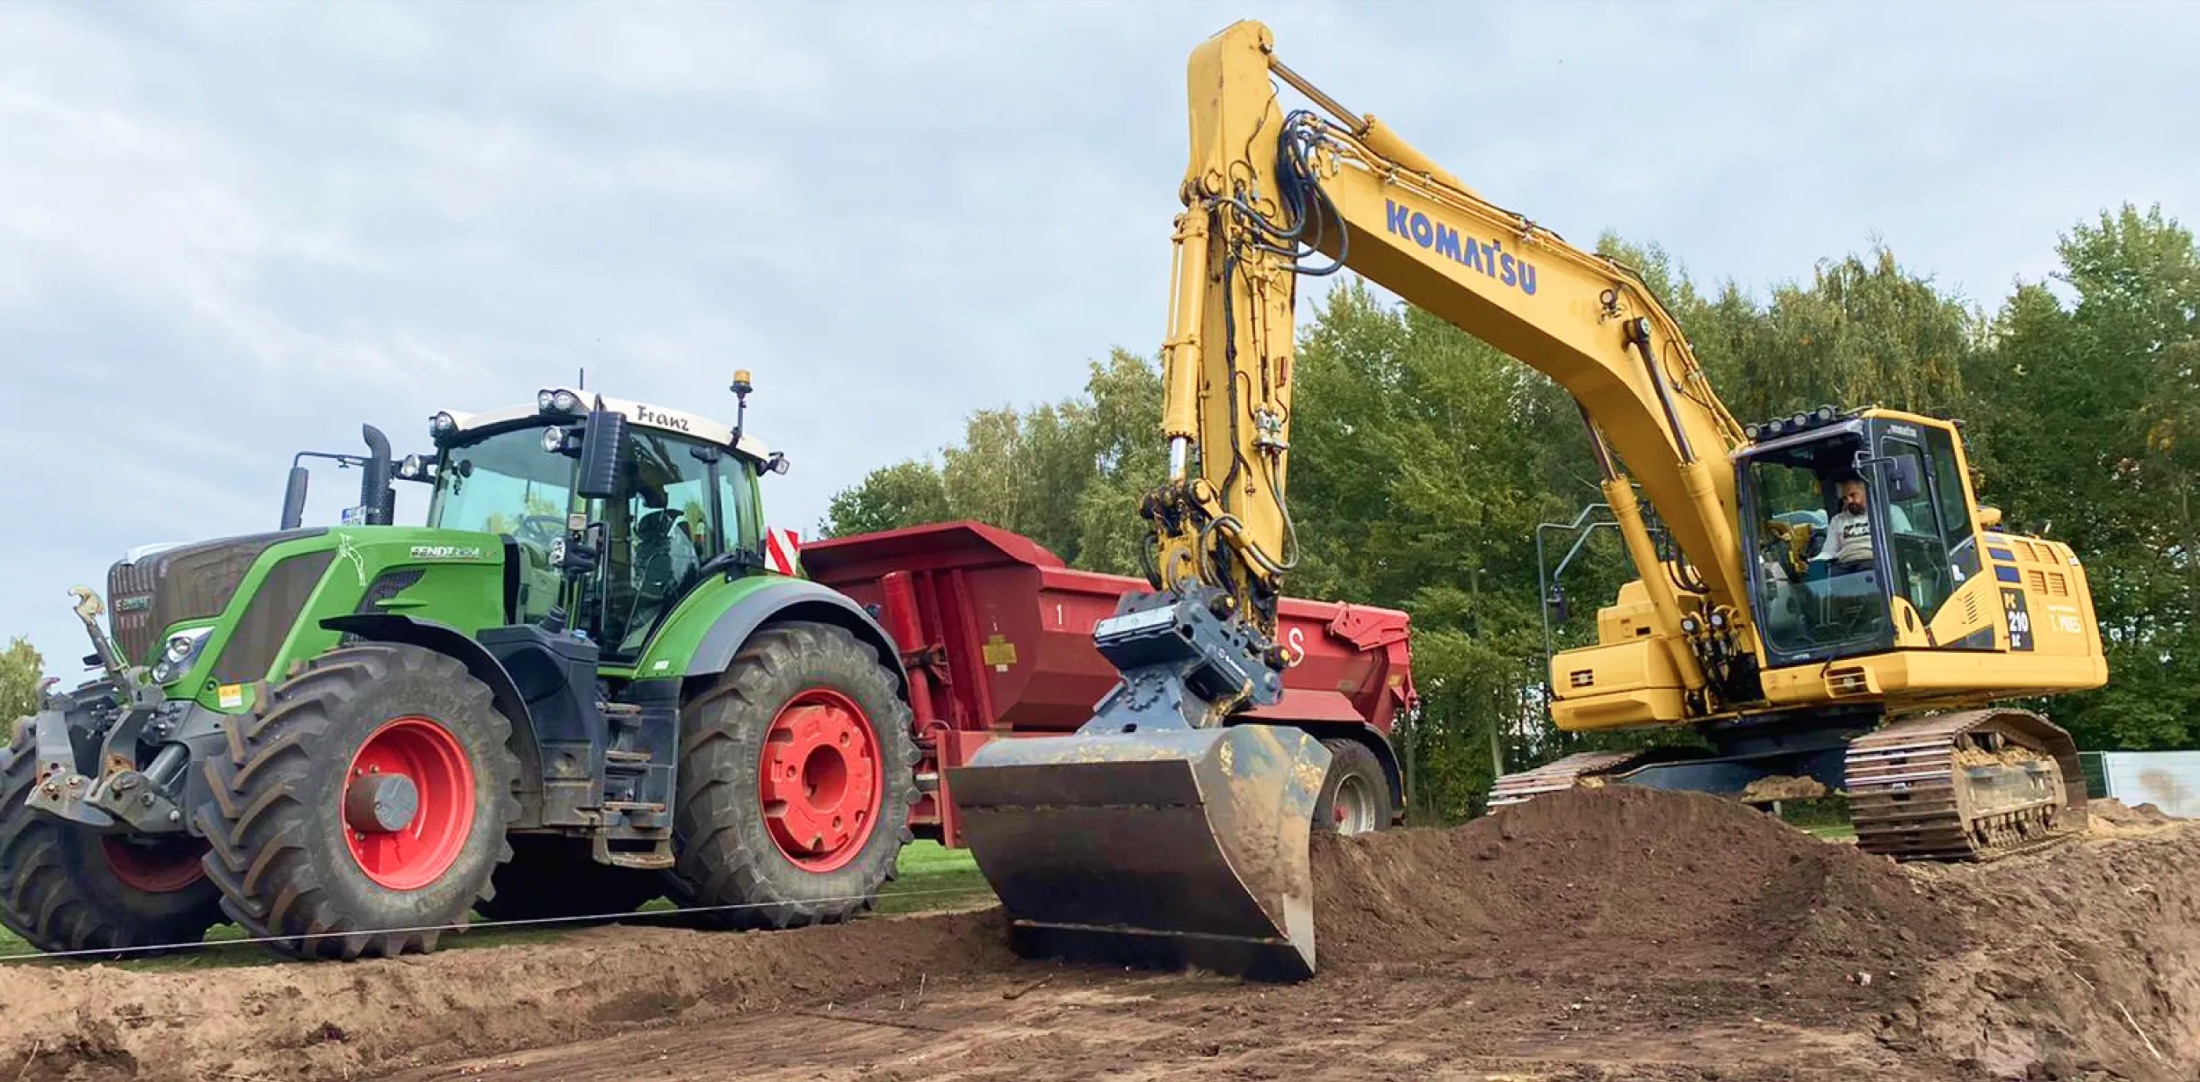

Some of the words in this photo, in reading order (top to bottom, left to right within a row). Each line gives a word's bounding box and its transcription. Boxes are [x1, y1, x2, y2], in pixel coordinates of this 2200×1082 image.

[1385, 198, 1537, 296] KOMATSU
[637, 404, 689, 431] Franz
[410, 545, 455, 558] FENDT
[2004, 592, 2017, 609] PC
[1056, 604, 1063, 625] 1
[2008, 611, 2029, 632] 210
[1288, 627, 1304, 667] S
